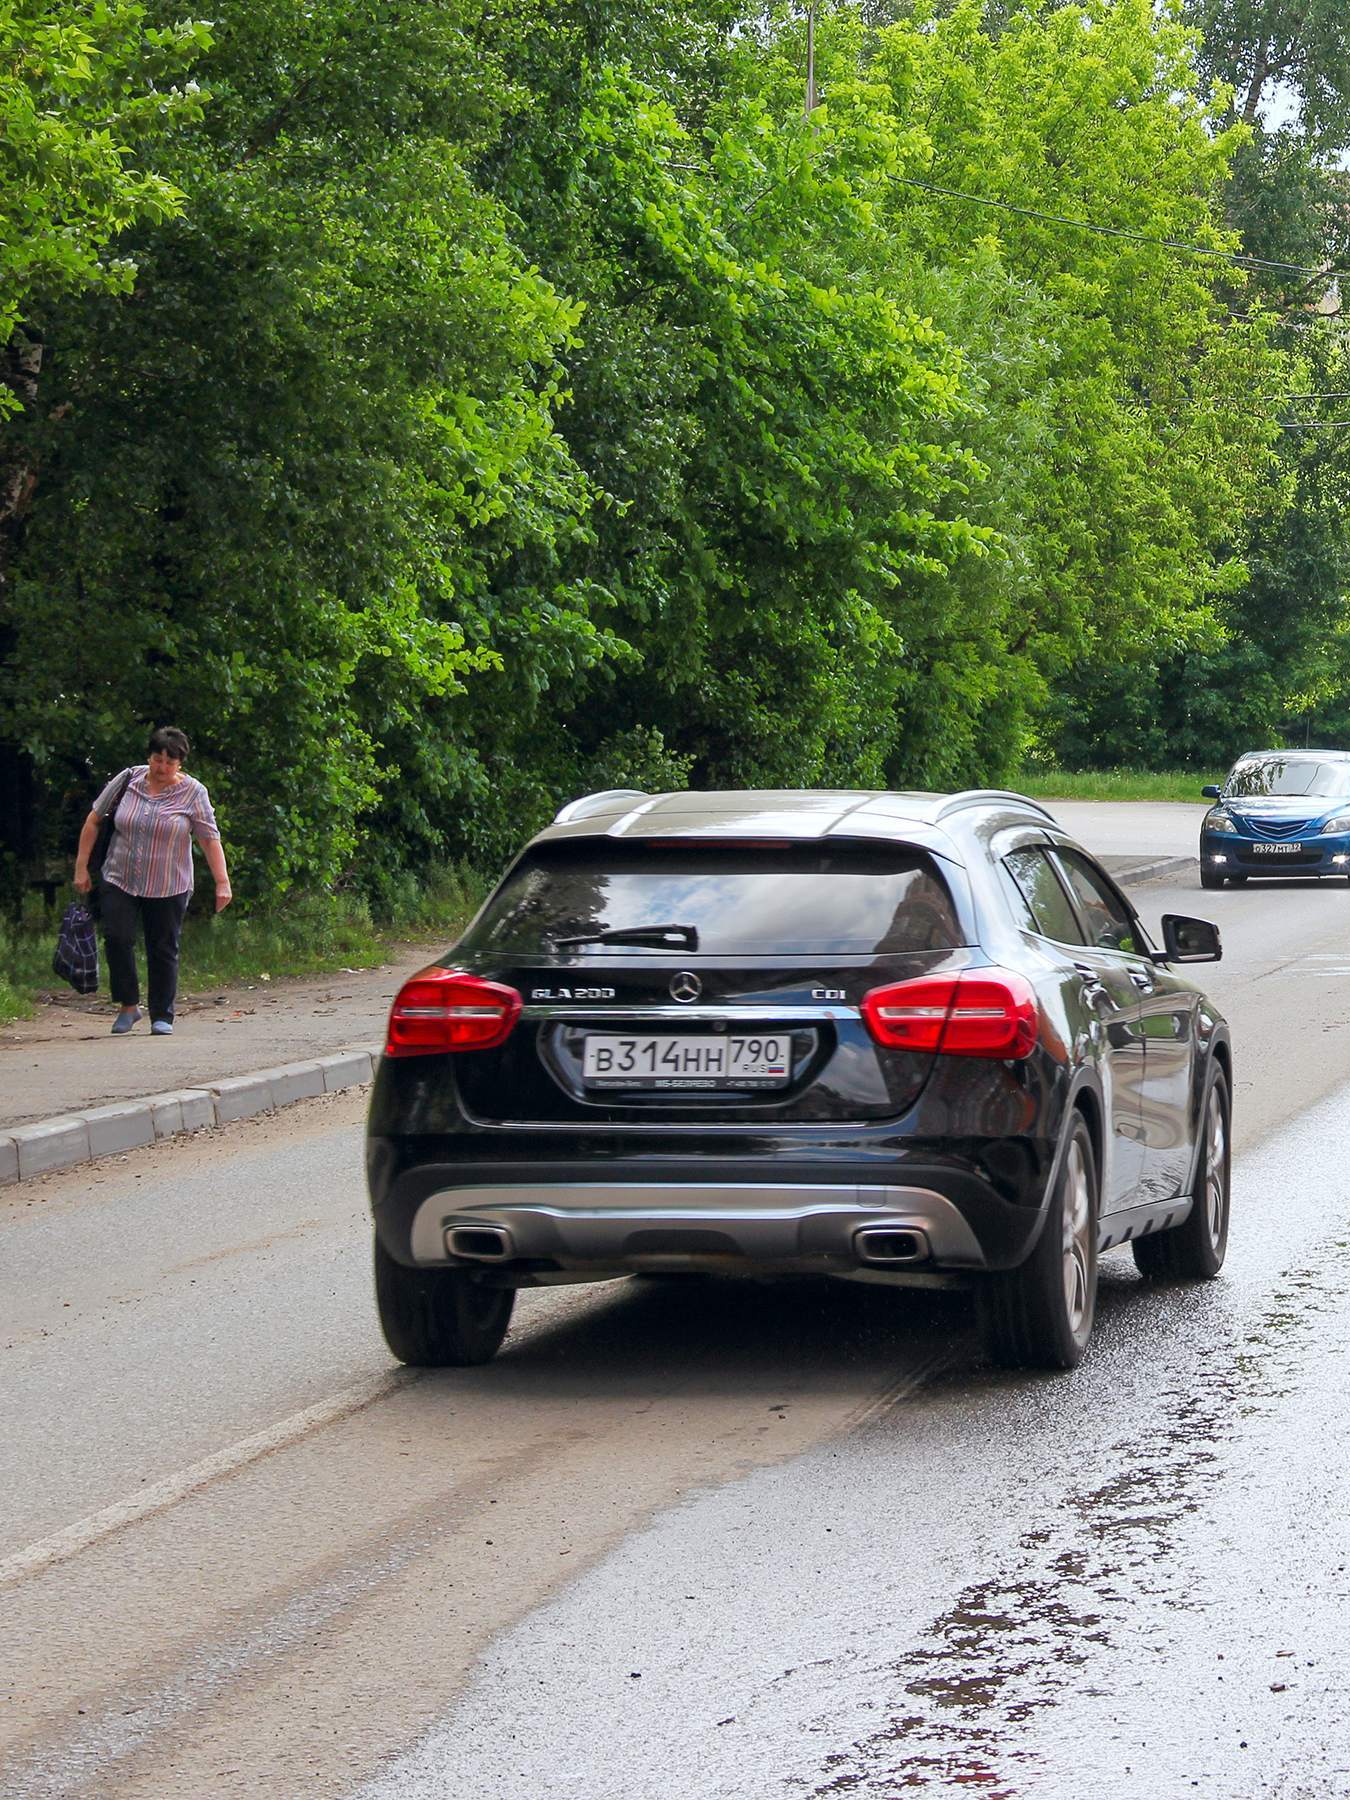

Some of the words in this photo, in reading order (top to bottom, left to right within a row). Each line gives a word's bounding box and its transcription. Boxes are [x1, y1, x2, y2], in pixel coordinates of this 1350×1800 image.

[531, 988, 572, 999] GLA
[574, 988, 615, 999] 200
[811, 988, 846, 999] CDI
[596, 1040, 722, 1072] В314НН
[731, 1039, 779, 1063] 790
